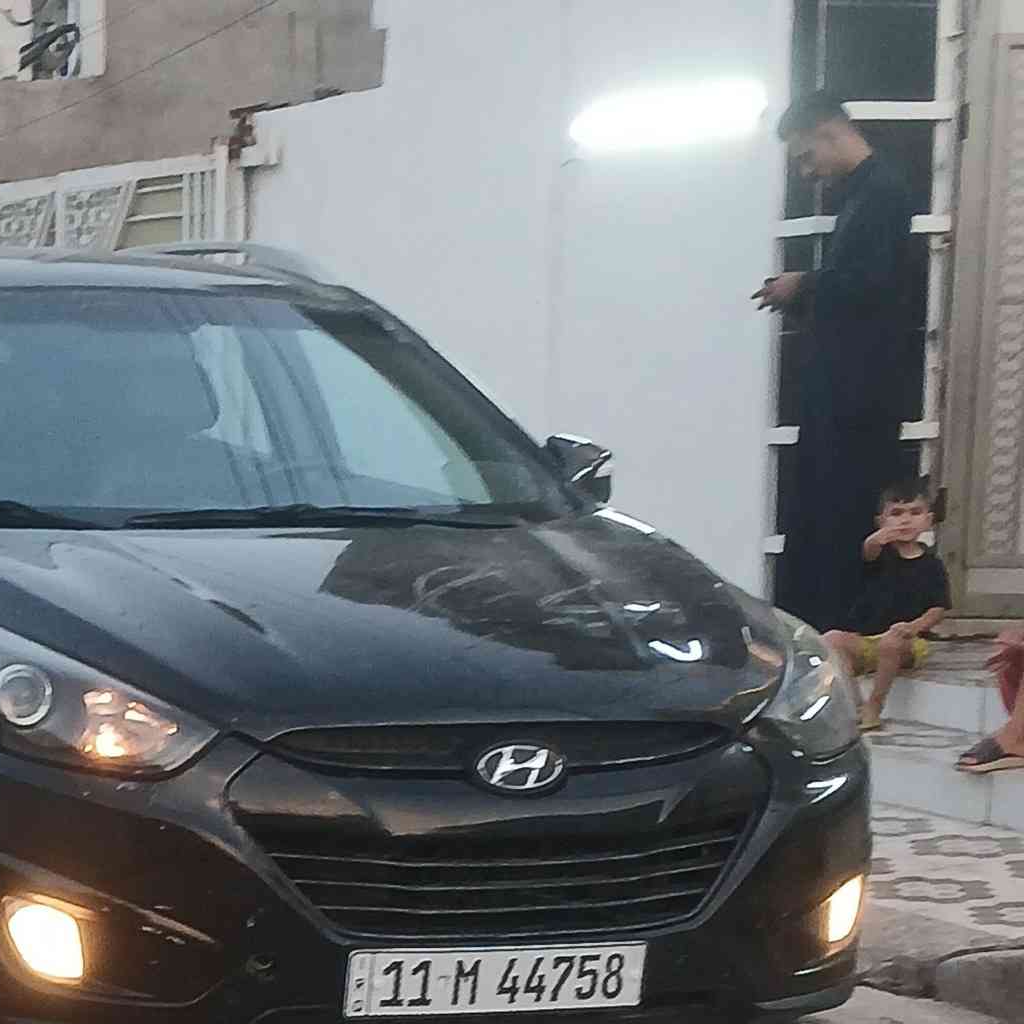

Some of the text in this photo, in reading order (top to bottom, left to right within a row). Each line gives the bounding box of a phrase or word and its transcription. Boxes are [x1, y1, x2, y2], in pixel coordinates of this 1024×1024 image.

[379, 960, 433, 1007] 11
[450, 959, 482, 1006] M
[495, 953, 625, 1004] 44758
